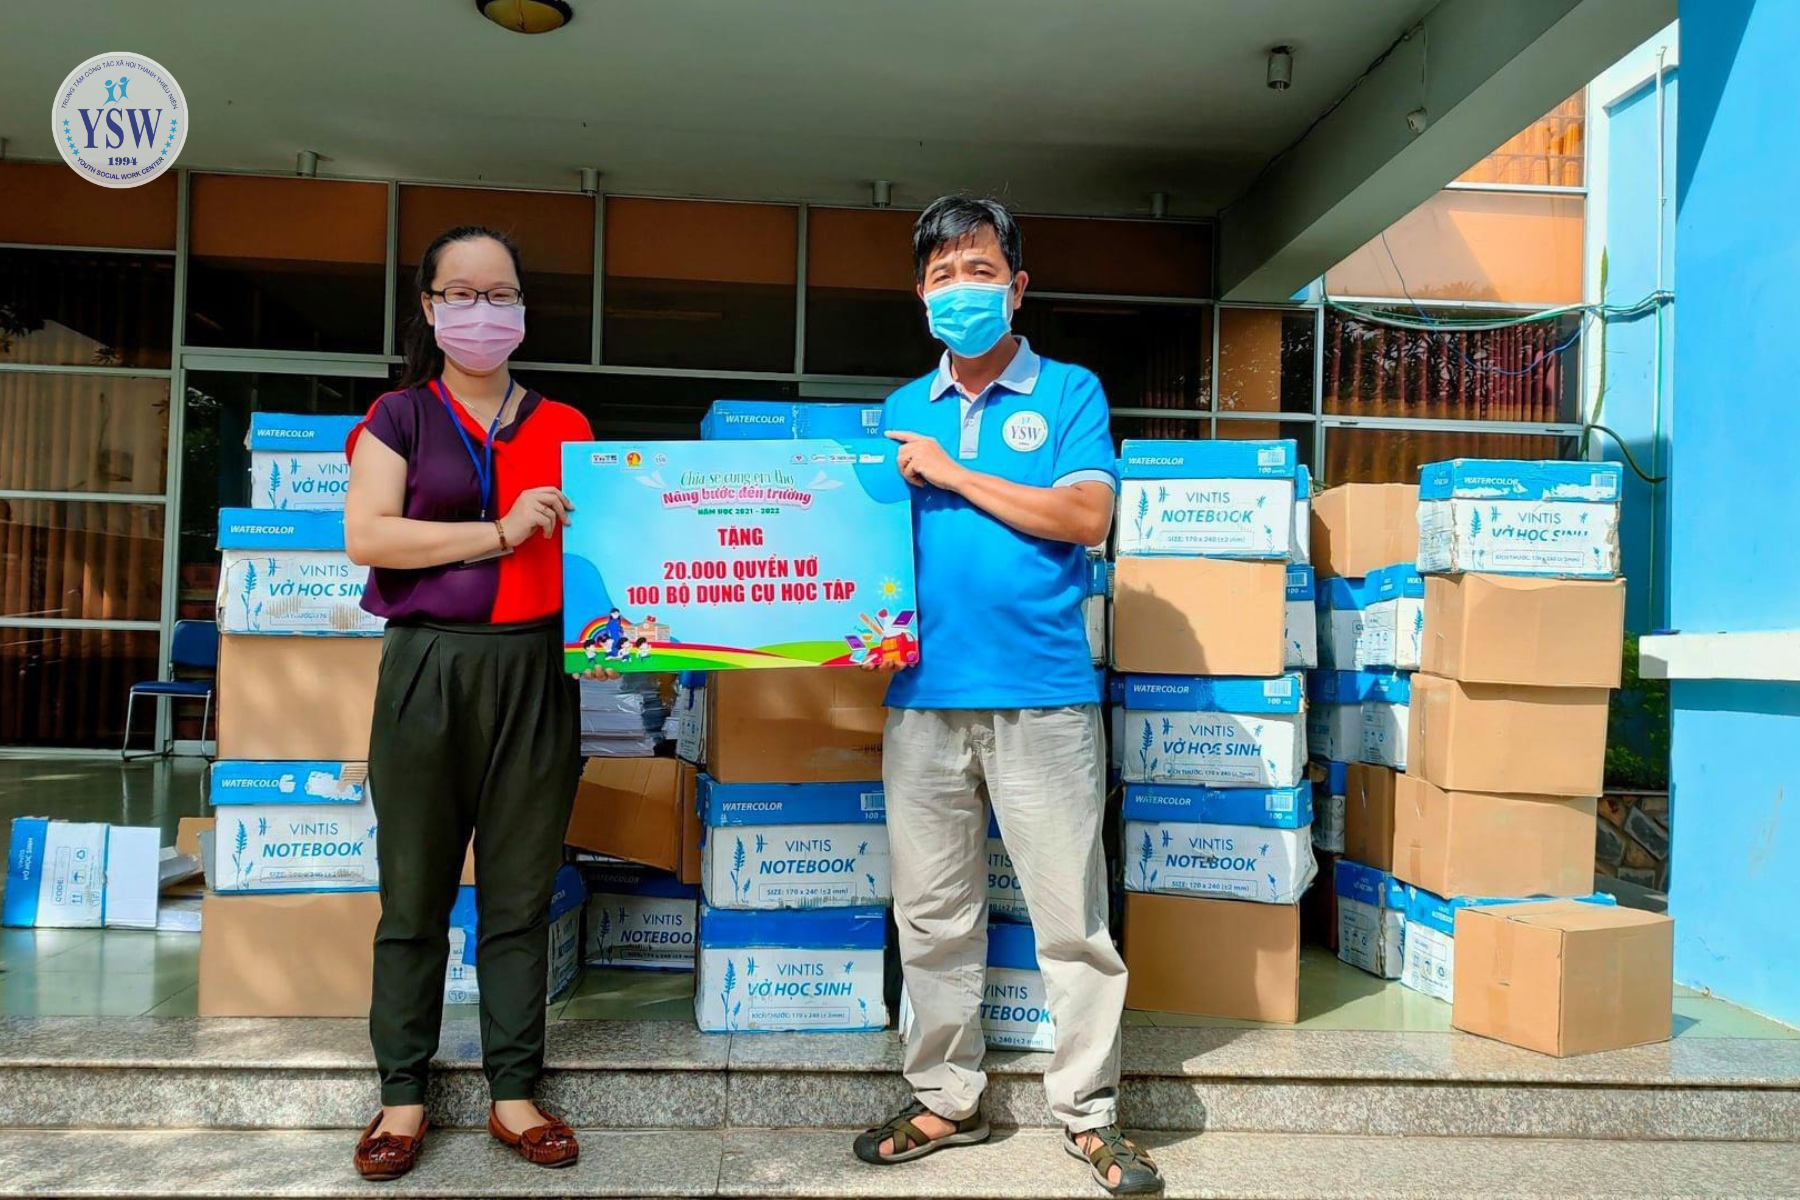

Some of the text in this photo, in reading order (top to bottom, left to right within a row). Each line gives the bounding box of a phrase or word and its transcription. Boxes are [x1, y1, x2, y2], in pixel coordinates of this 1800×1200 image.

[725, 415, 785, 424] WATERCOLOR
[257, 428, 315, 438] WATERCOLOR
[1011, 426, 1041, 441] YSW
[1128, 456, 1185, 466] WATERCOLOR
[318, 463, 350, 475] VINT
[680, 470, 706, 486] Chia
[1464, 477, 1520, 486] WATERCOLOR
[292, 477, 313, 494] VỞ
[663, 484, 812, 505] Nâng bước đến trường
[1186, 491, 1231, 504] VINTIS
[761, 507, 780, 515] 2022
[1161, 509, 1255, 523] NOTEBOOK
[1518, 512, 1562, 525] VINTIS
[230, 525, 295, 535] WATERCOLOR
[717, 525, 764, 550] TẶNG
[300, 565, 349, 577] VINTIS
[663, 553, 818, 581] 20.000 QUYỂN VỞ
[269, 579, 365, 600] VỞ HỌC SIN
[627, 579, 855, 607] 100 BỘ DỤNG CỤ HỌC TẬP
[1133, 684, 1190, 694] WATERCOLOR
[1189, 725, 1235, 738] VINTIS
[1163, 737, 1262, 758] VỞ HỌC SINH
[222, 779, 280, 789] WATERCOLO
[722, 802, 783, 811] WATERCOLOR
[1135, 795, 1191, 806] WATERCOLOR
[290, 823, 339, 835] VINTIS
[262, 842, 364, 858] NOTEBOOK
[785, 839, 832, 852] VINTIS
[1189, 837, 1234, 851] VINTIS
[759, 858, 856, 875] NOTEBOOK
[988, 853, 1012, 868] TIS
[1165, 854, 1256, 872] NOTEBOOK
[767, 888, 784, 896] SIZE:
[643, 914, 683, 926] VINTIS
[621, 930, 695, 944] NOTEBOO
[777, 963, 824, 976] VINTIS
[748, 978, 853, 1000] VỞ HỌC SINH
[981, 1004, 1051, 1023] TEBOOK
